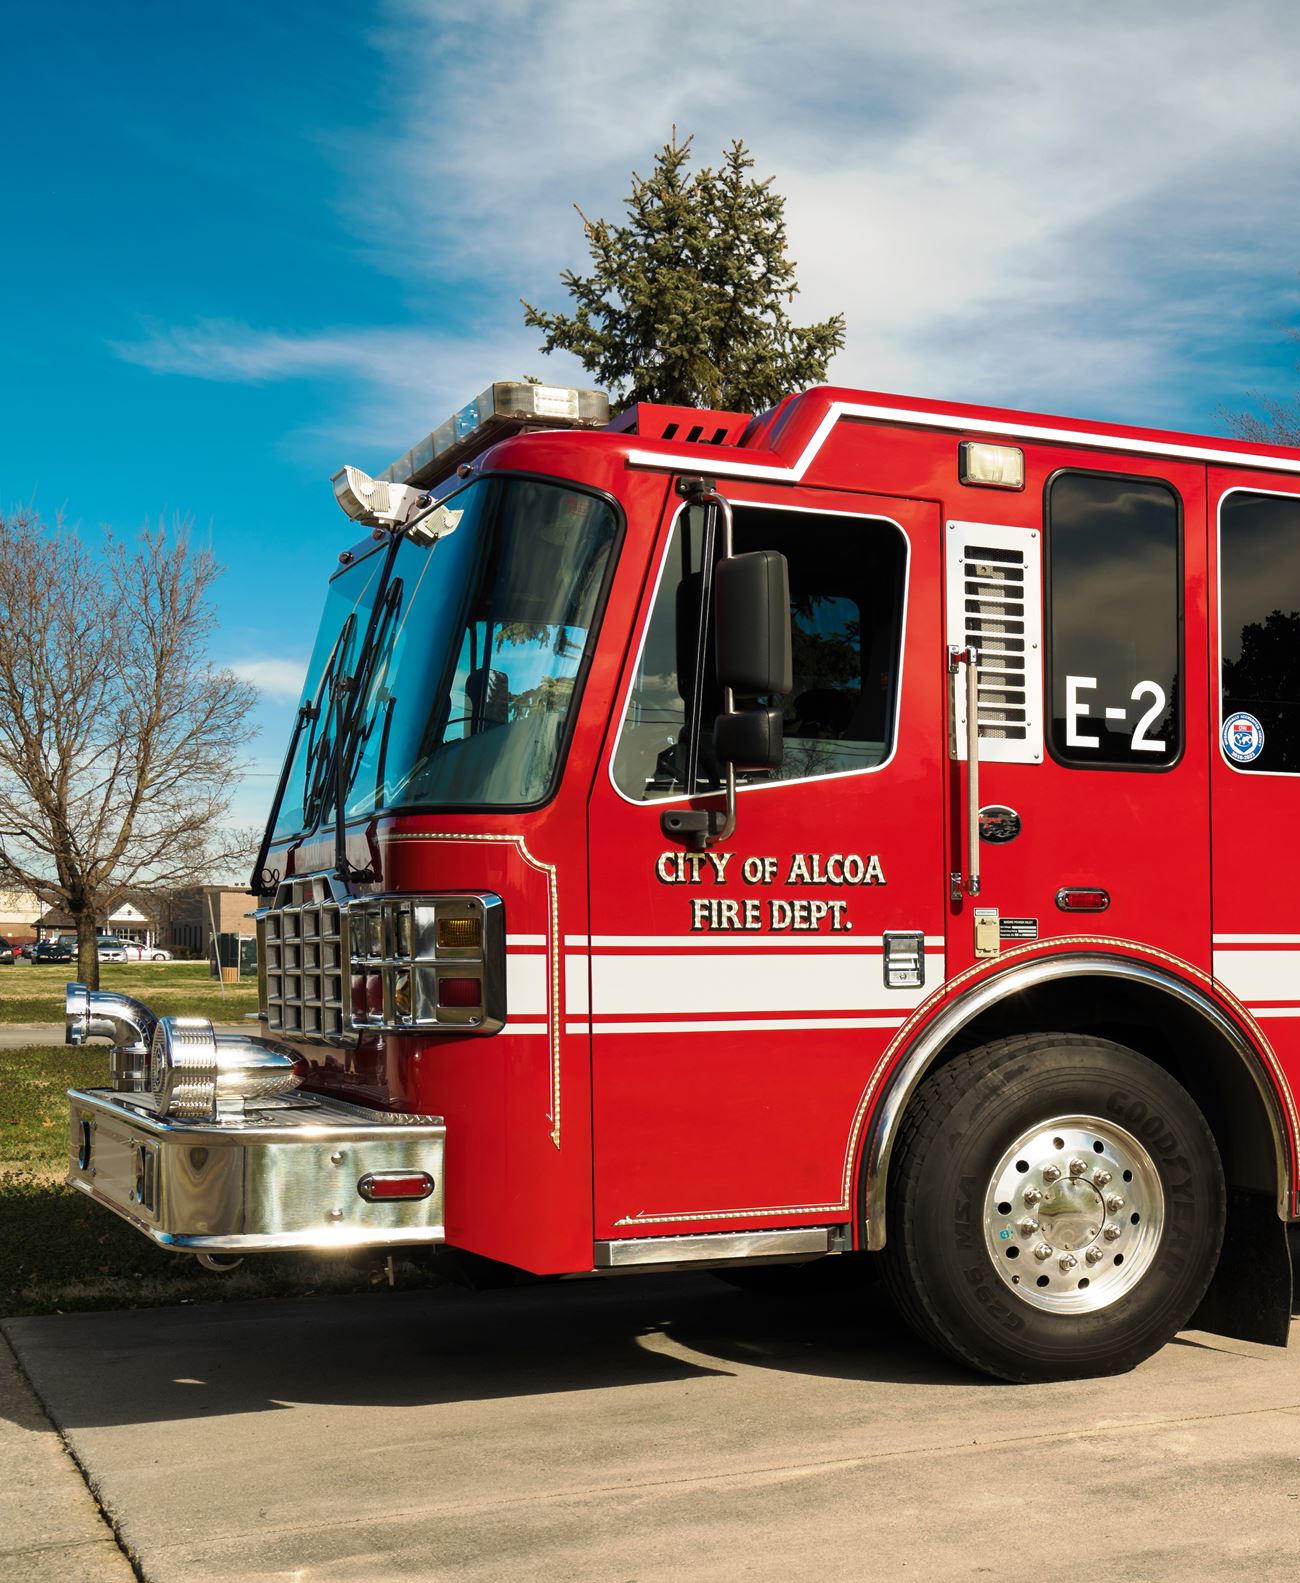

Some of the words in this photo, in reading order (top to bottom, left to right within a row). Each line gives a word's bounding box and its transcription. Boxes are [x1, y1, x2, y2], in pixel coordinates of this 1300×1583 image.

[1065, 675, 1166, 752] E-2
[656, 851, 735, 884] CITY
[742, 857, 778, 886] OF
[785, 854, 888, 886] ALCOA
[689, 899, 762, 931] FIRE
[768, 900, 853, 932] DEPT.
[1106, 1089, 1196, 1280] GOODYEAR
